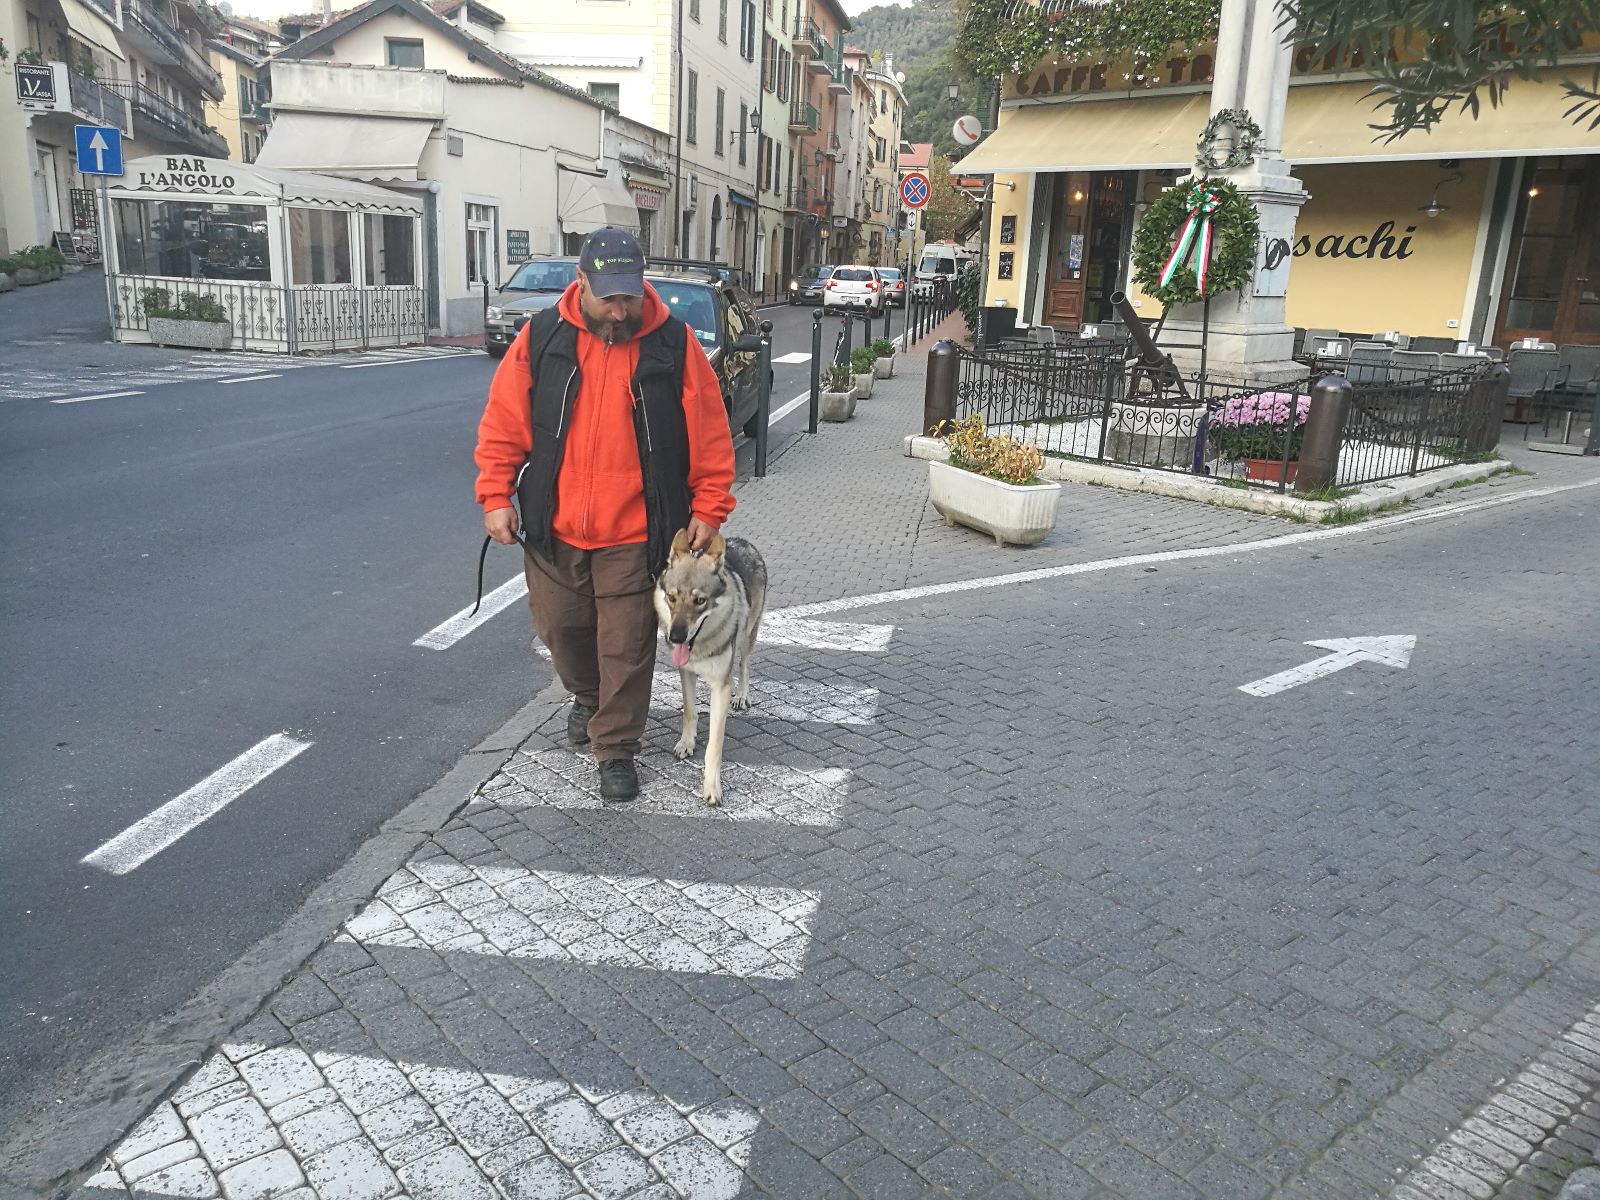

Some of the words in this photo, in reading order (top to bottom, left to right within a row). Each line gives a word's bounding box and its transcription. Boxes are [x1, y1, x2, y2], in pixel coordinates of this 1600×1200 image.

[18, 67, 50, 76] RISTORANTE
[166, 157, 207, 172] BAR
[139, 172, 235, 188] L'ANGOLO
[1292, 219, 1417, 260] sachi
